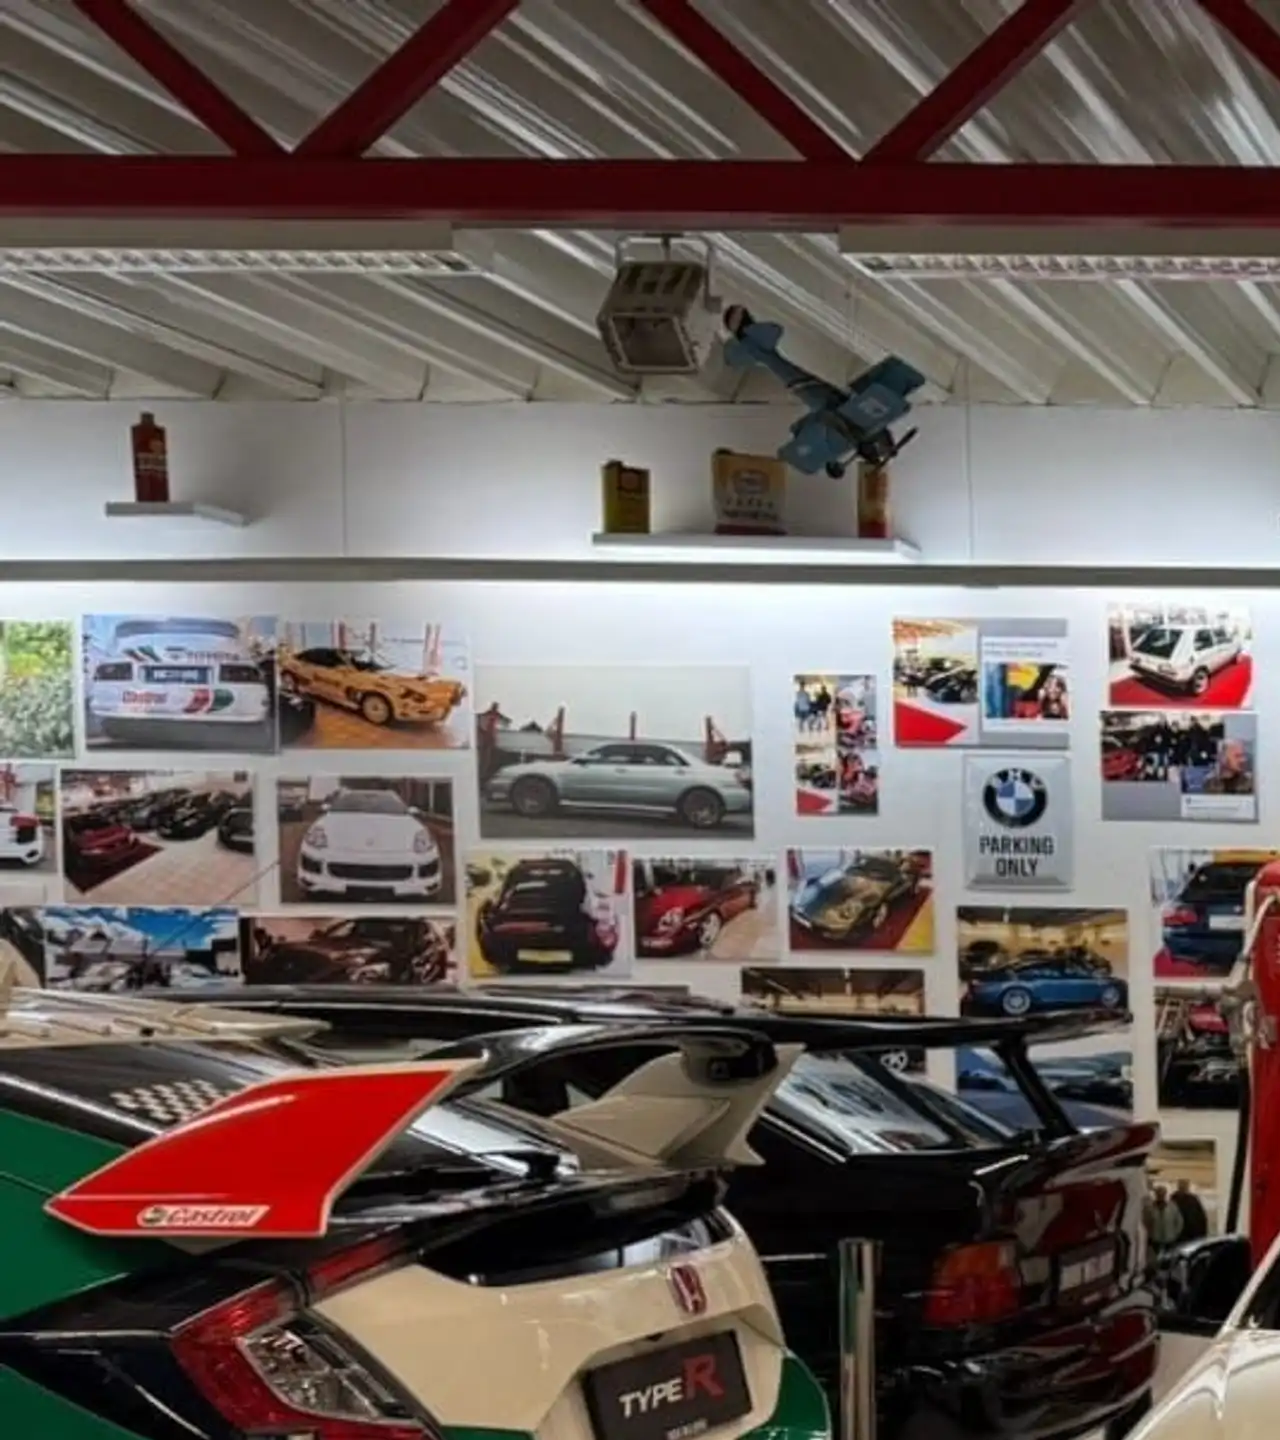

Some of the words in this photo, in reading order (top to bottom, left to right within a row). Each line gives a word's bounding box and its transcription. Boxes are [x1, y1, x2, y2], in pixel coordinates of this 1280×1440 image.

[979, 835, 1055, 856] PARKING
[996, 858, 1038, 877] ONLY
[168, 1207, 259, 1224] Castrol
[619, 1378, 684, 1418] TYPE
[684, 1354, 724, 1398] R
